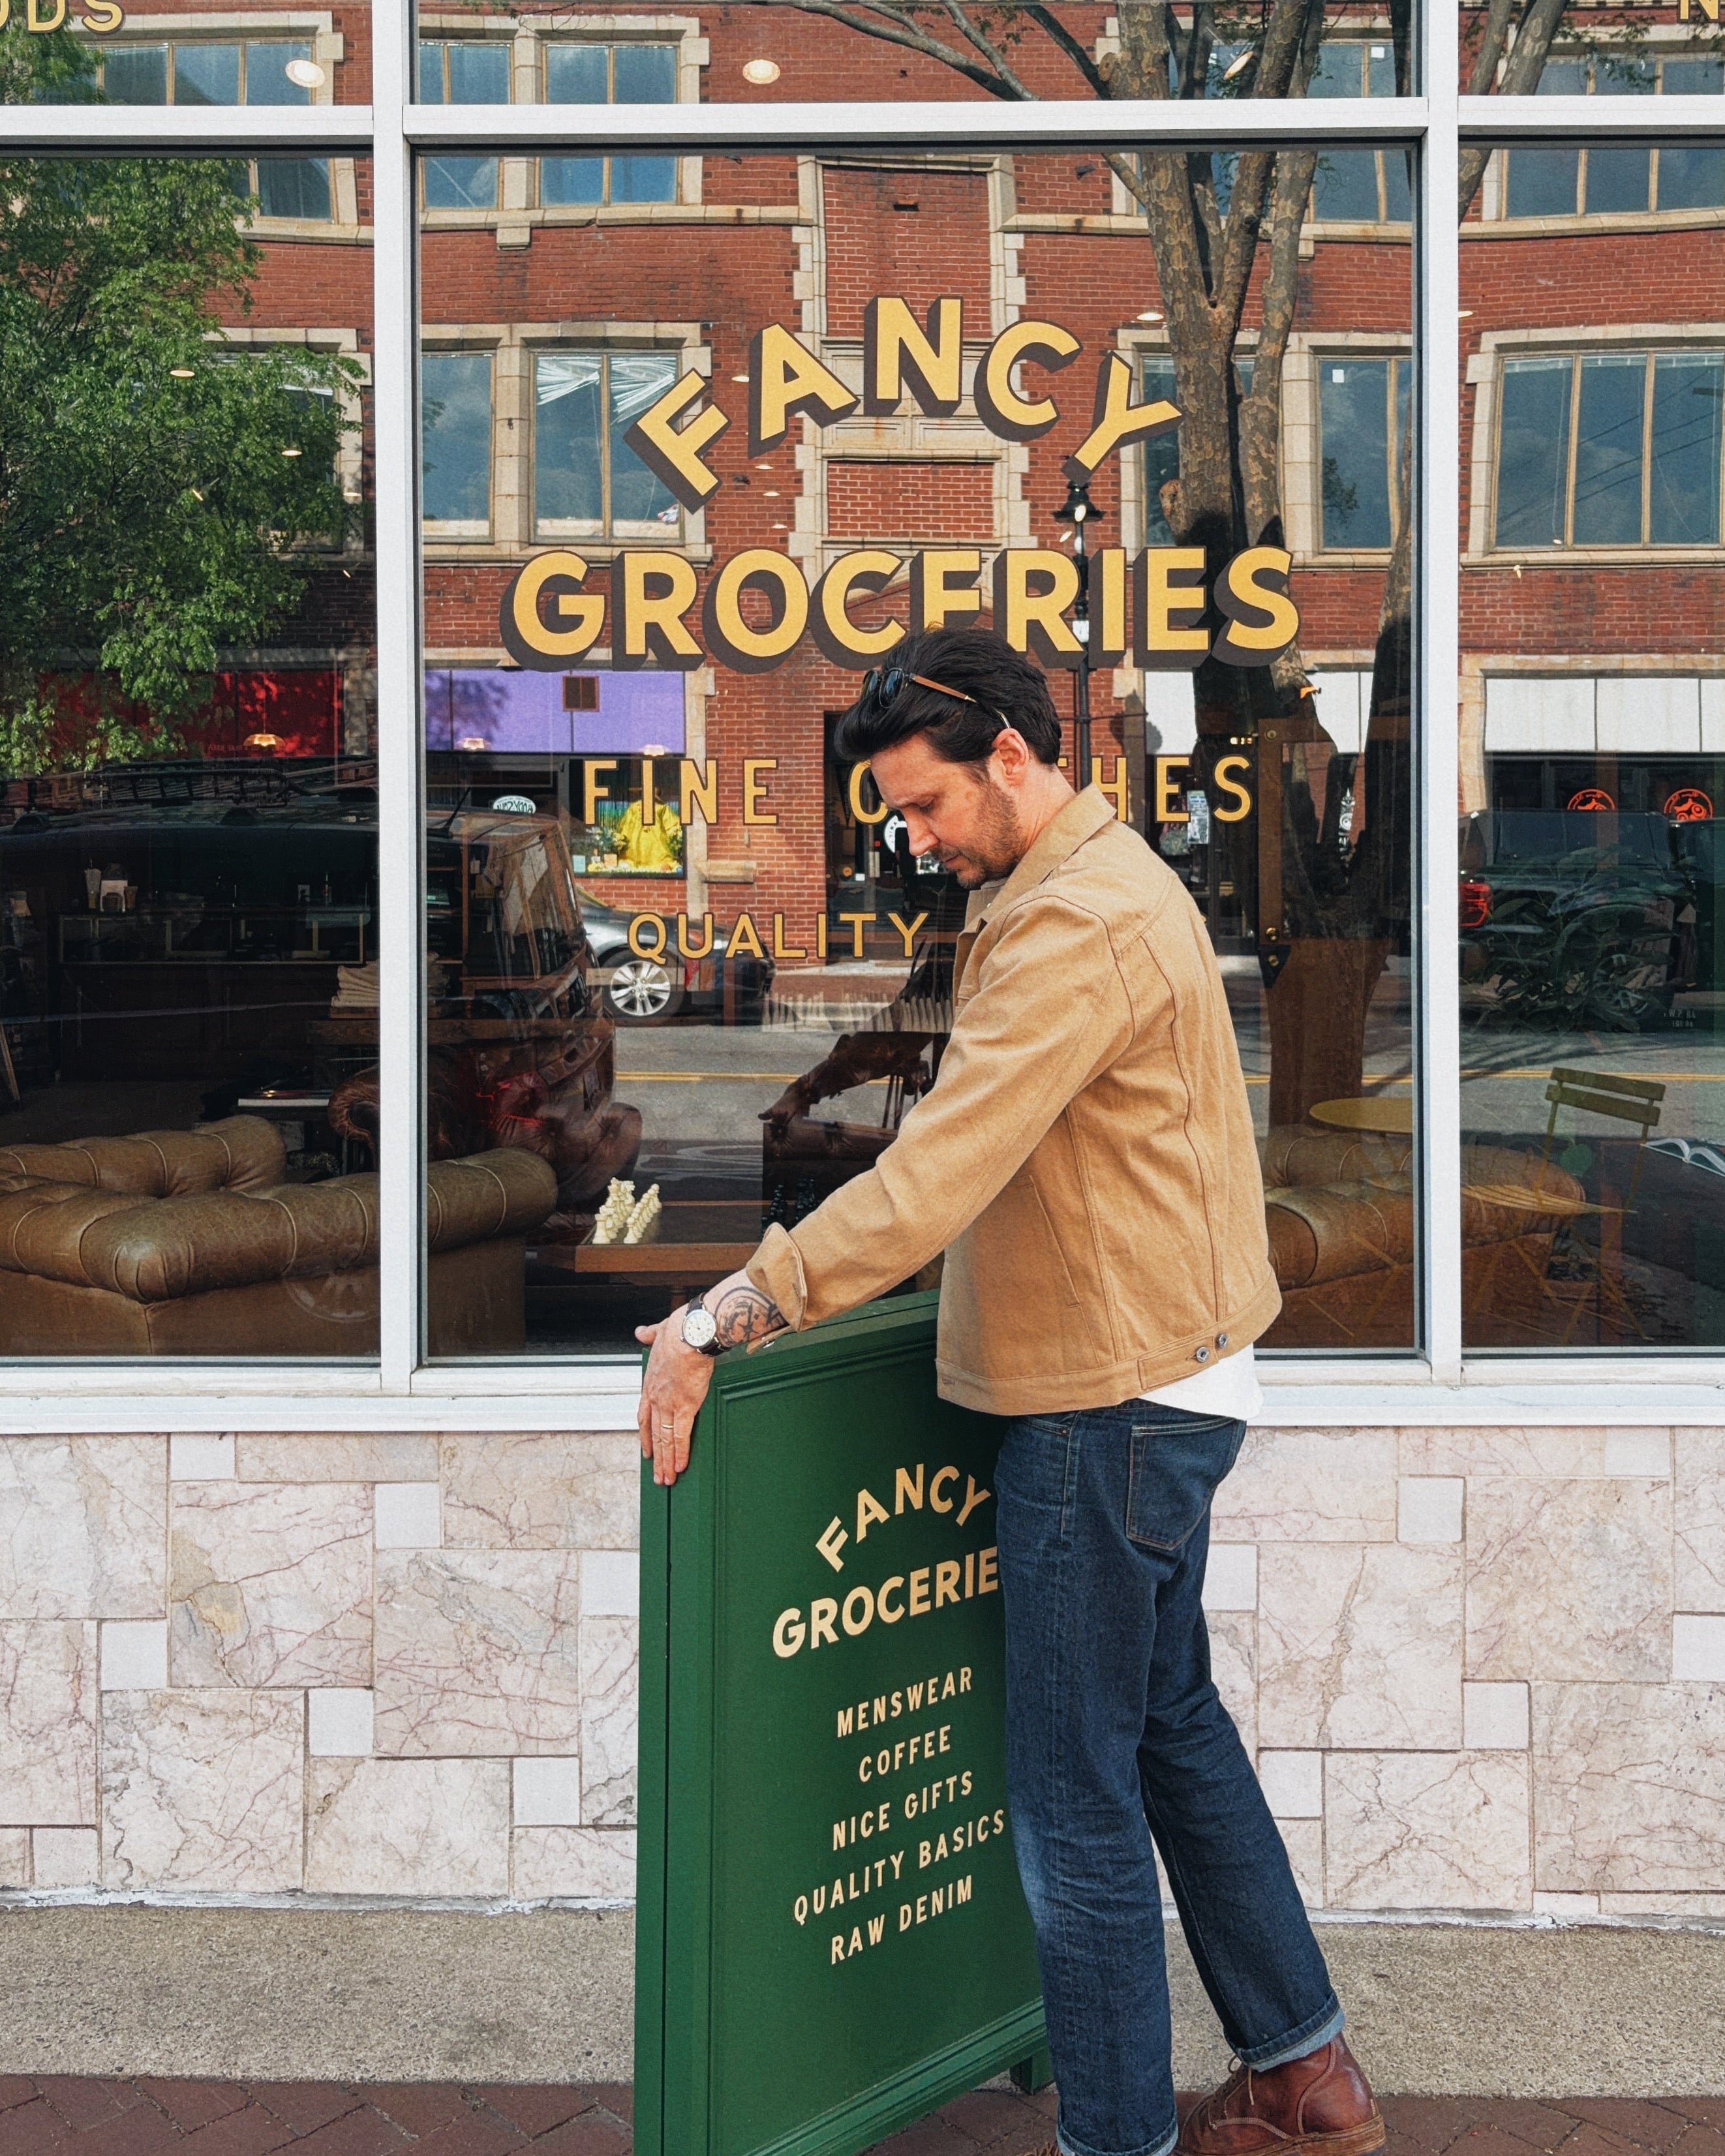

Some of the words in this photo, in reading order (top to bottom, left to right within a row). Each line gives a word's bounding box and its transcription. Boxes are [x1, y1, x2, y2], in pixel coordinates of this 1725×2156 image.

[624, 296, 1183, 514] FANCY
[499, 546, 1300, 673] GROCERIES
[584, 758, 779, 826] FINE
[627, 912, 930, 965] QUALITY
[815, 1463, 991, 1572] FANCY
[772, 1546, 998, 1659] GROCERIE
[837, 1667, 972, 1738] MENSWEAR
[859, 1725, 951, 1782] COFFEE
[832, 1802, 890, 1851] NICE
[904, 1771, 973, 1819] GIFTS
[793, 1851, 905, 1926] QUALITY
[919, 1810, 1004, 1869] BASICS
[831, 1915, 885, 1965] RAW
[900, 1875, 972, 1932] DENIM
